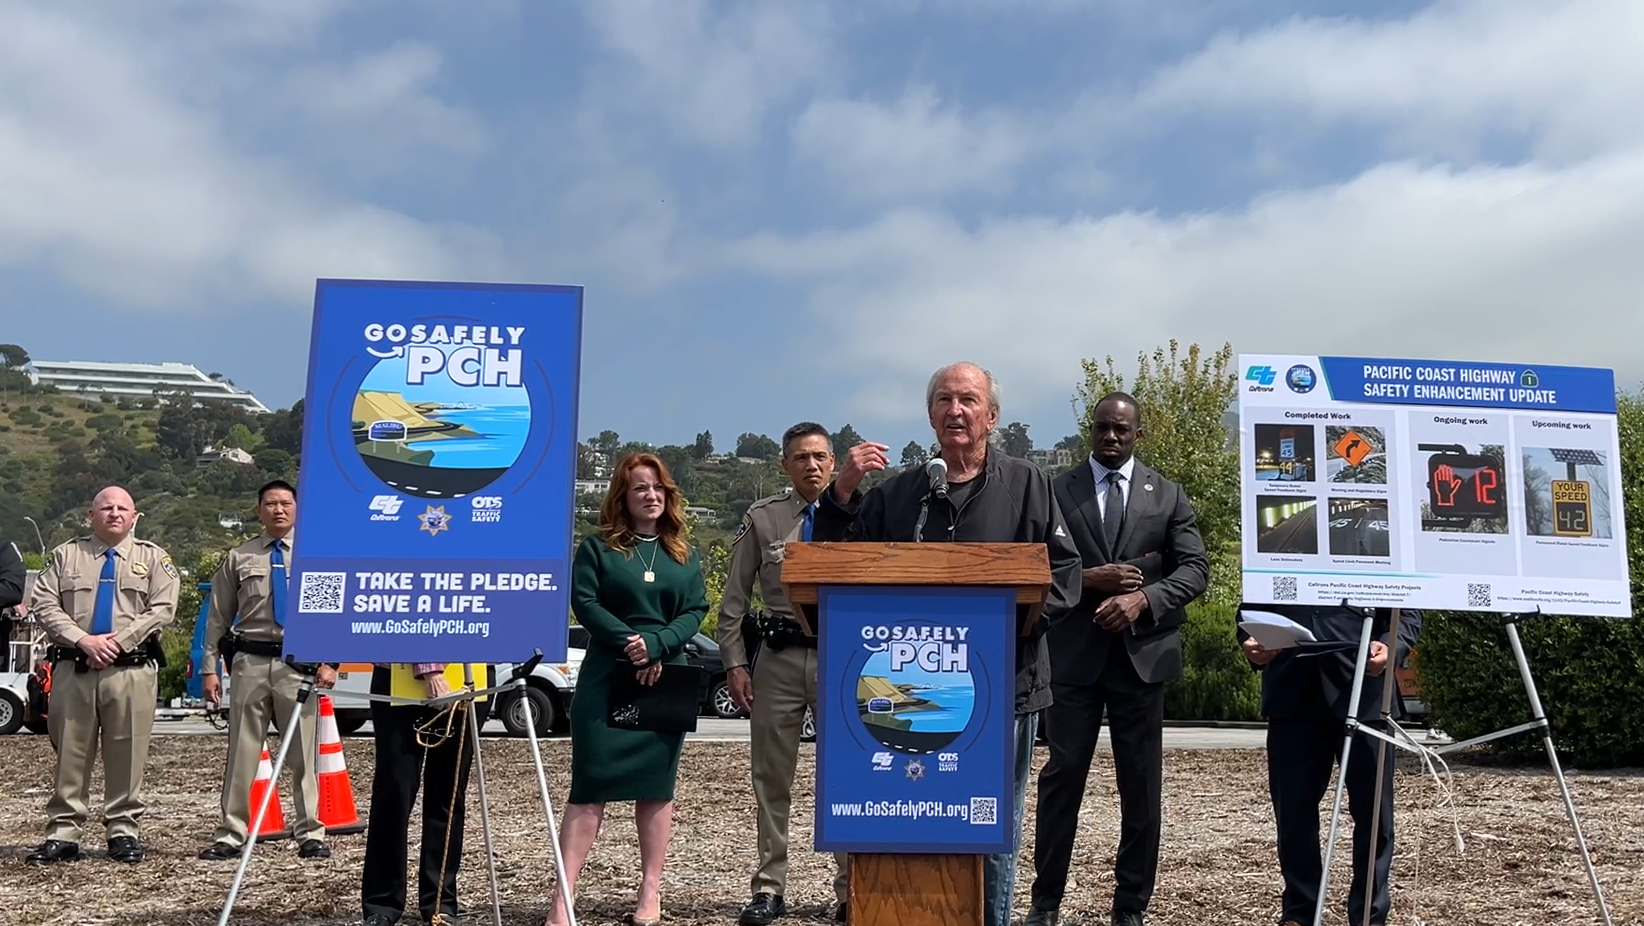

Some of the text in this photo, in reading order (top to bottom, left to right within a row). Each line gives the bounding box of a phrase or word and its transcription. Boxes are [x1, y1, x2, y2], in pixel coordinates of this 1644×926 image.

[410, 324, 526, 345] SAFELY
[406, 345, 523, 387] PCH
[1363, 365, 1516, 384] PACIFIC COAST HIGHWAY
[1363, 383, 1557, 404] SAFETY ENHANCEMENT UPDATE
[1284, 411, 1328, 419] Completed
[1433, 416, 1467, 425] Ongoing
[1532, 420, 1592, 430] Upcoming work
[1281, 449, 1293, 457] 45
[1474, 468, 1497, 504] 12
[1556, 482, 1584, 491] YOUR
[1554, 492, 1588, 501] SPEED
[1559, 510, 1586, 530] 42
[355, 572, 558, 591] TAKE THE PLEDGE.
[353, 595, 491, 613] SAVE A LIFE.
[351, 618, 490, 638] www.GoSafelyPCH.org
[892, 626, 969, 640] SAFELY
[891, 642, 968, 672] PCH
[831, 800, 969, 821] www.GoSafelyPCH.org
